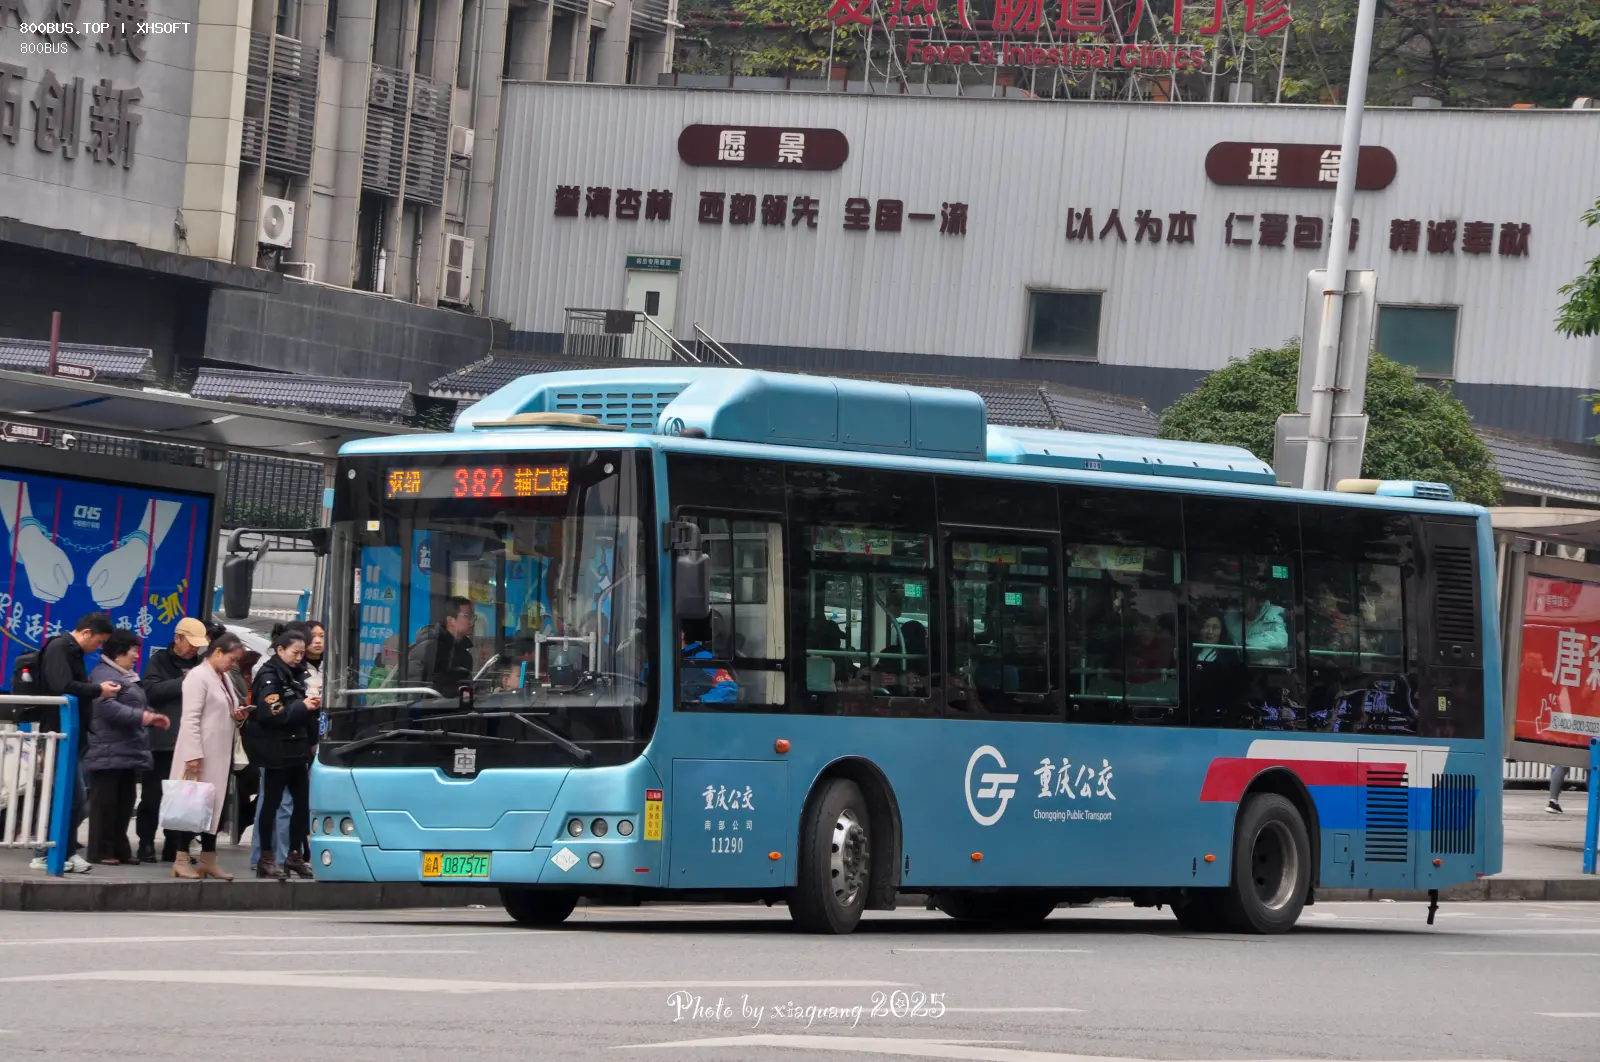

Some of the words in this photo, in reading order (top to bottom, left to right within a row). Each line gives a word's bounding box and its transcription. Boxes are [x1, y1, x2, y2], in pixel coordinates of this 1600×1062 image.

[906, 39, 971, 65] Fever
[979, 41, 998, 65] &
[1002, 41, 1115, 69] Intestinal
[1120, 43, 1206, 69] Clinics
[717, 129, 805, 164] 愿景
[1247, 147, 1342, 183] 理念
[552, 184, 674, 222] 誉满杏林
[697, 190, 820, 229] 西部领先
[843, 196, 969, 236] 全国一流
[1065, 206, 1198, 245] 以人为本
[1388, 217, 1532, 257] 精诚奉献
[453, 467, 505, 498] 382
[514, 467, 569, 497] 辅仁路
[1033, 757, 1117, 801] 重庆公交
[701, 785, 755, 810] 重庆公交
[704, 820, 753, 831] 南部公司
[1033, 808, 1066, 822] Chongqing
[1066, 809, 1084, 820] Public
[1084, 810, 1112, 822] Transport
[711, 837, 744, 853] 11290
